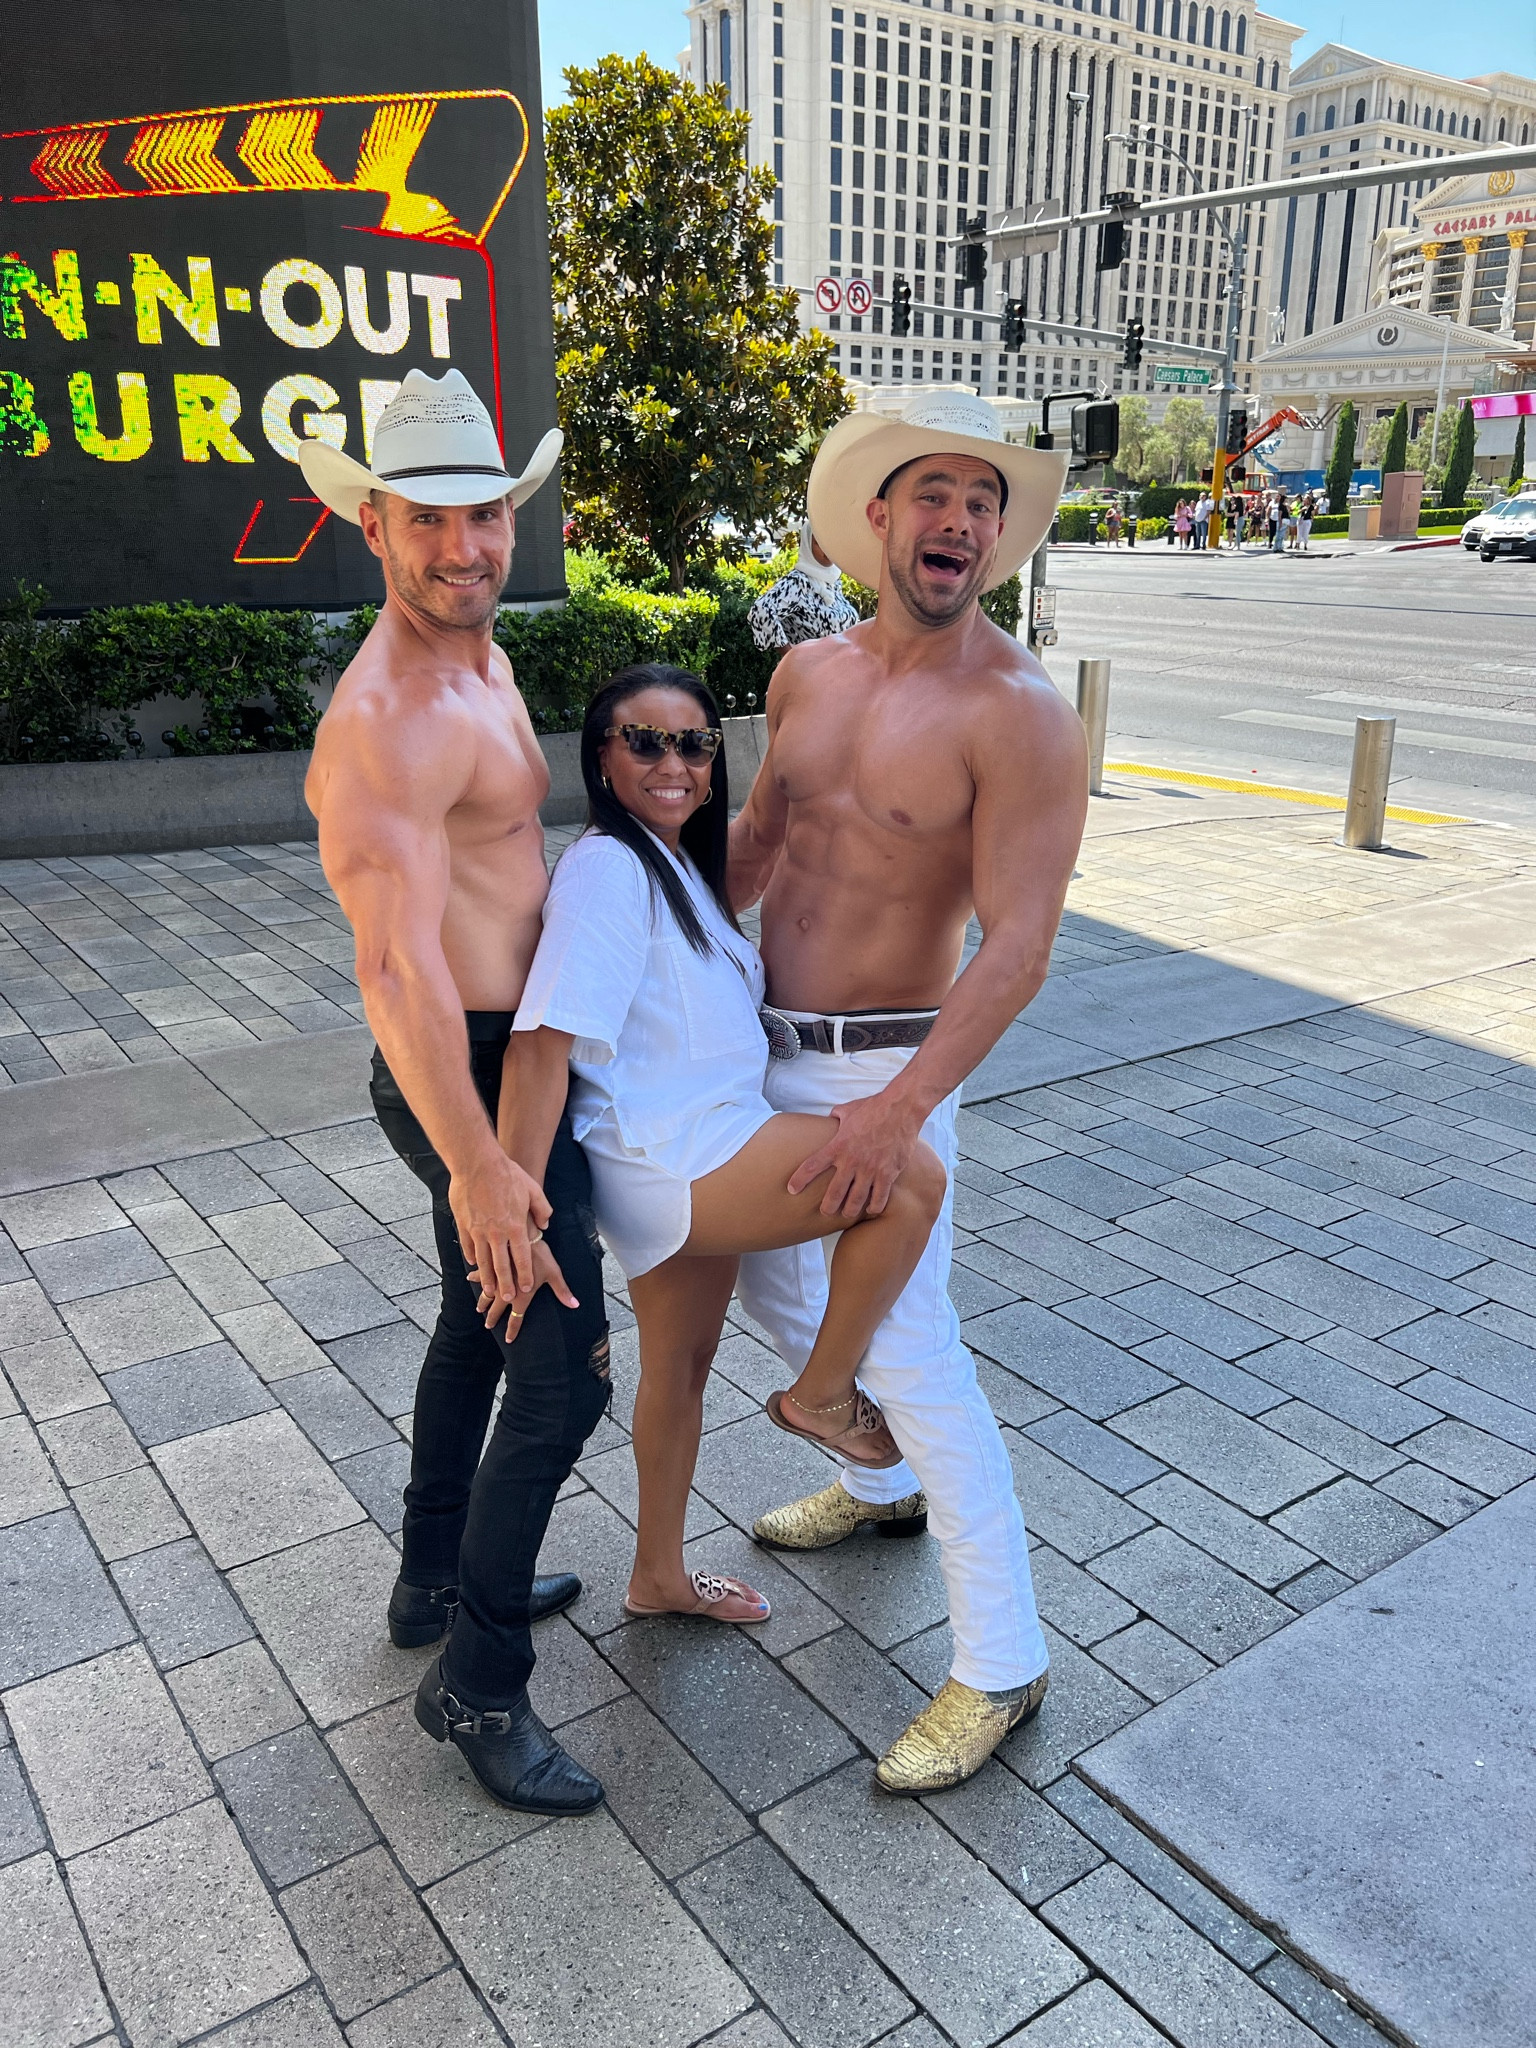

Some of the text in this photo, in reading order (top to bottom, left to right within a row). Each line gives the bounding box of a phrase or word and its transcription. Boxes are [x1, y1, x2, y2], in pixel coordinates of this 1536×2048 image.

[1433, 209, 1536, 235] CAESARS PAL
[1156, 368, 1181, 381] Caesars
[1183, 369, 1203, 383] Palace
